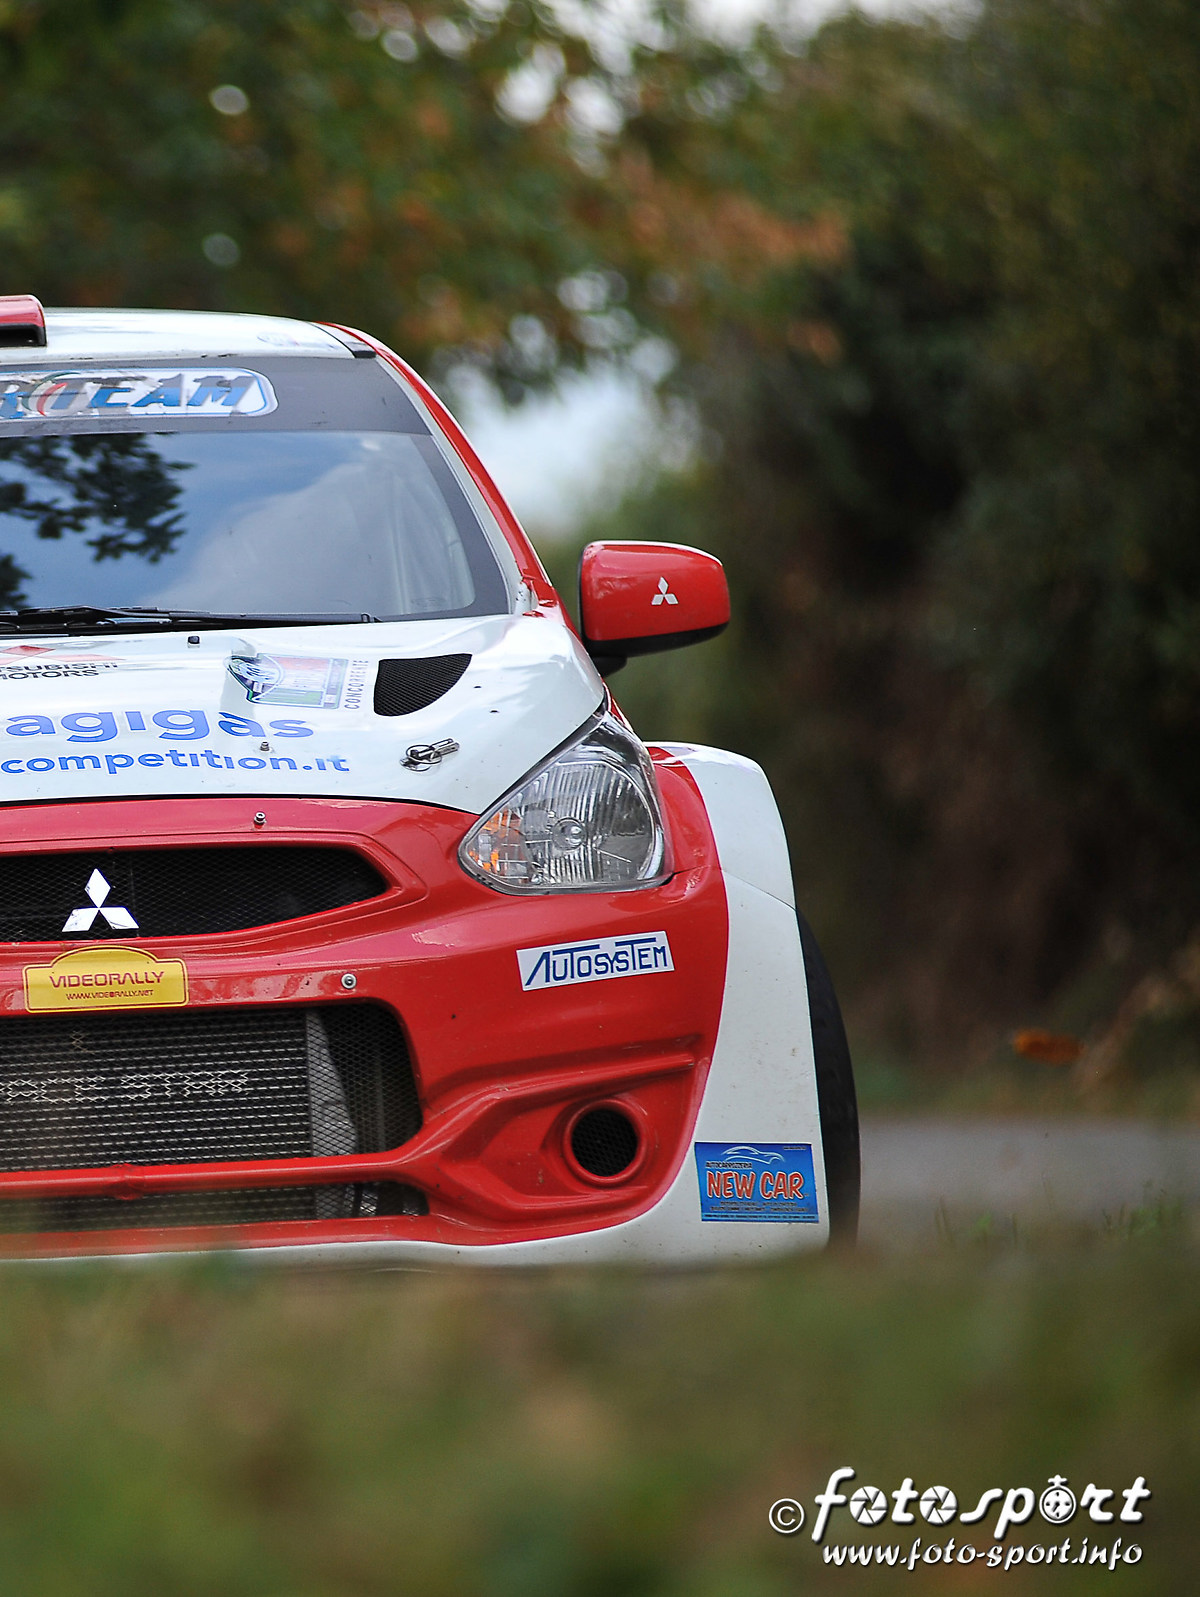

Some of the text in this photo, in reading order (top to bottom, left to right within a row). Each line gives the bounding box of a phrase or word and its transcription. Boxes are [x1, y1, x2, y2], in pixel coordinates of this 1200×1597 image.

[46, 375, 260, 411] TEAM
[525, 937, 667, 986] AUTOSYSTEM
[50, 971, 164, 988] VIDEORALLY
[120, 1070, 248, 1098] STAR
[706, 1170, 805, 1200] NEW CAR
